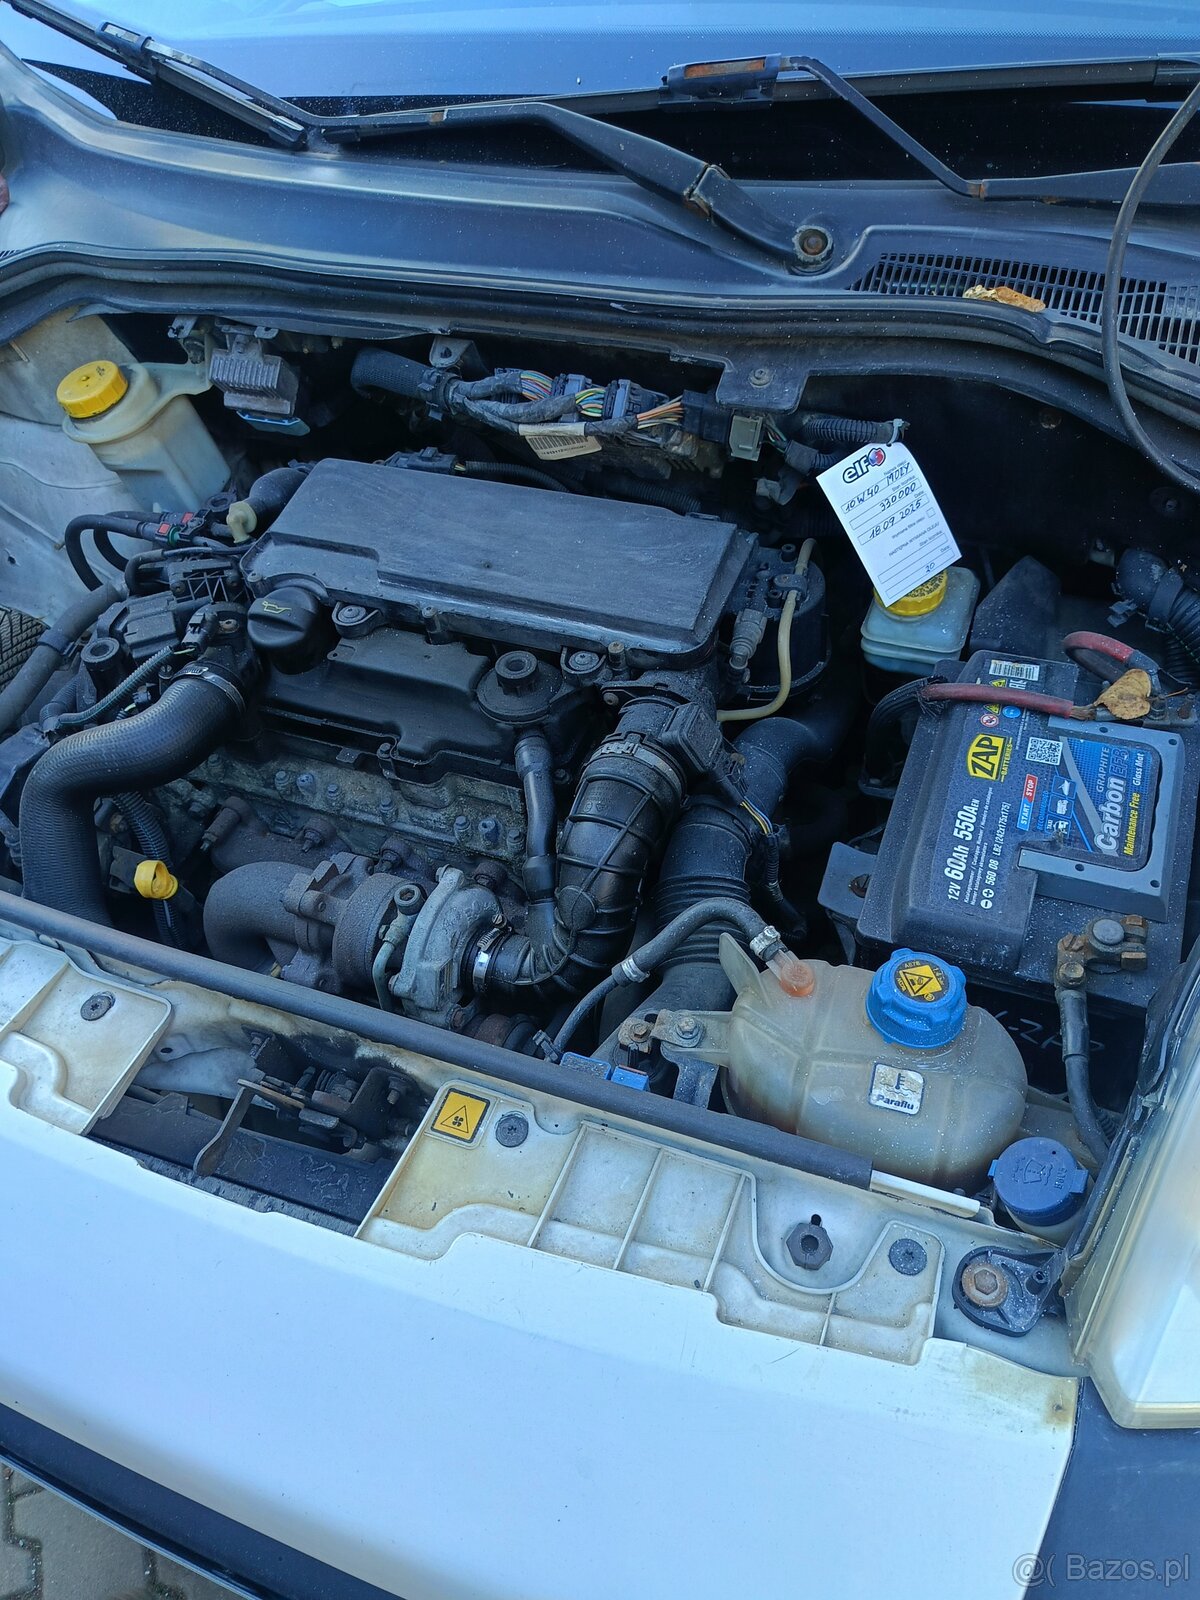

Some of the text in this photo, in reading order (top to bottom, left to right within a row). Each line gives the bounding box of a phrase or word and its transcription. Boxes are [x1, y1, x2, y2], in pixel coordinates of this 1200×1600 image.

[842, 455, 871, 484] elf
[971, 738, 999, 779] ZAP
[1001, 742, 1013, 775] BATTERIES
[1095, 746, 1110, 792] GRAPHITE
[1021, 779, 1034, 824] START STOP
[1036, 789, 1049, 830] RECOMMENDED
[1095, 746, 1130, 852] Carbon EFB
[1123, 752, 1144, 856] Maintenance Free Glass Mat
[944, 843, 970, 880] 60Ah
[988, 858, 999, 870] 08
[992, 843, 1002, 855] LB2
[948, 881, 961, 901] 12V
[984, 870, 997, 885] 560
[876, 1094, 914, 1110] Paraflu
